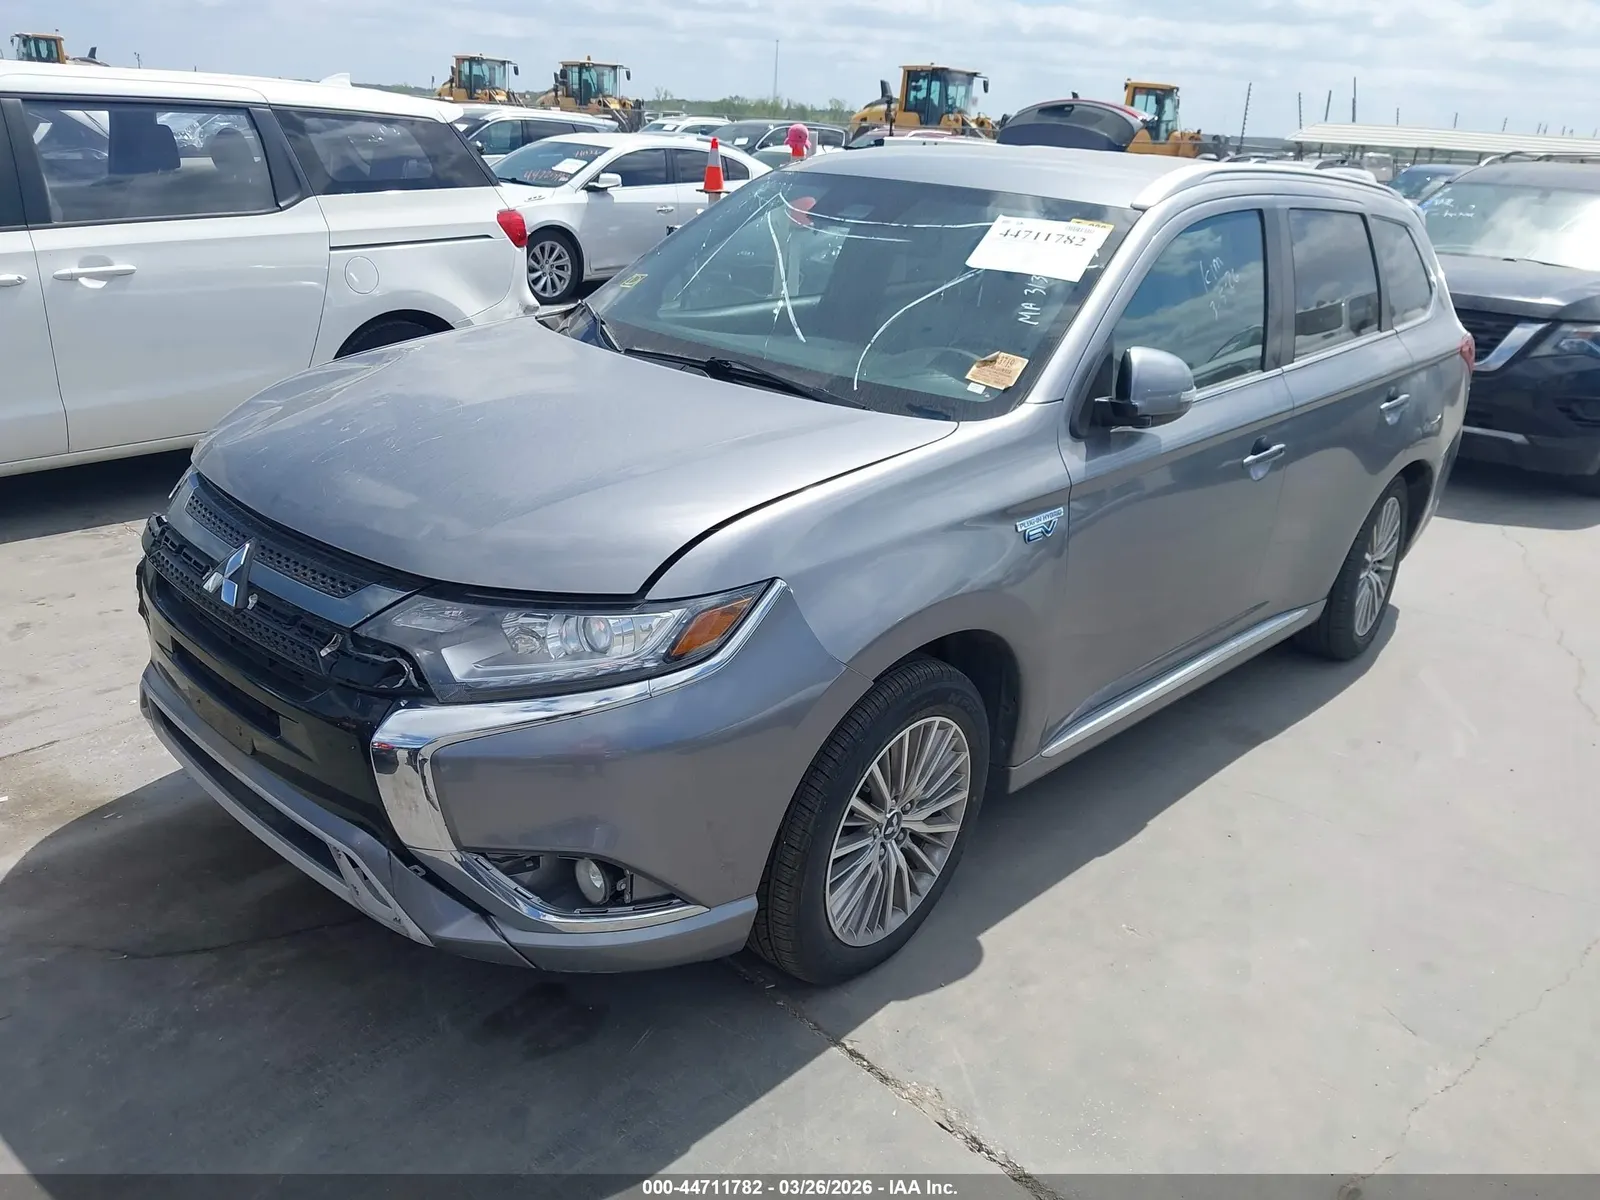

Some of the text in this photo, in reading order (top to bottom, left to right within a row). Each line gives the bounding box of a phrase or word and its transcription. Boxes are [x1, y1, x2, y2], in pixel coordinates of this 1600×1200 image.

[999, 228, 1087, 247] 44711782
[1018, 302, 1041, 325] MA
[1026, 518, 1058, 544] EV
